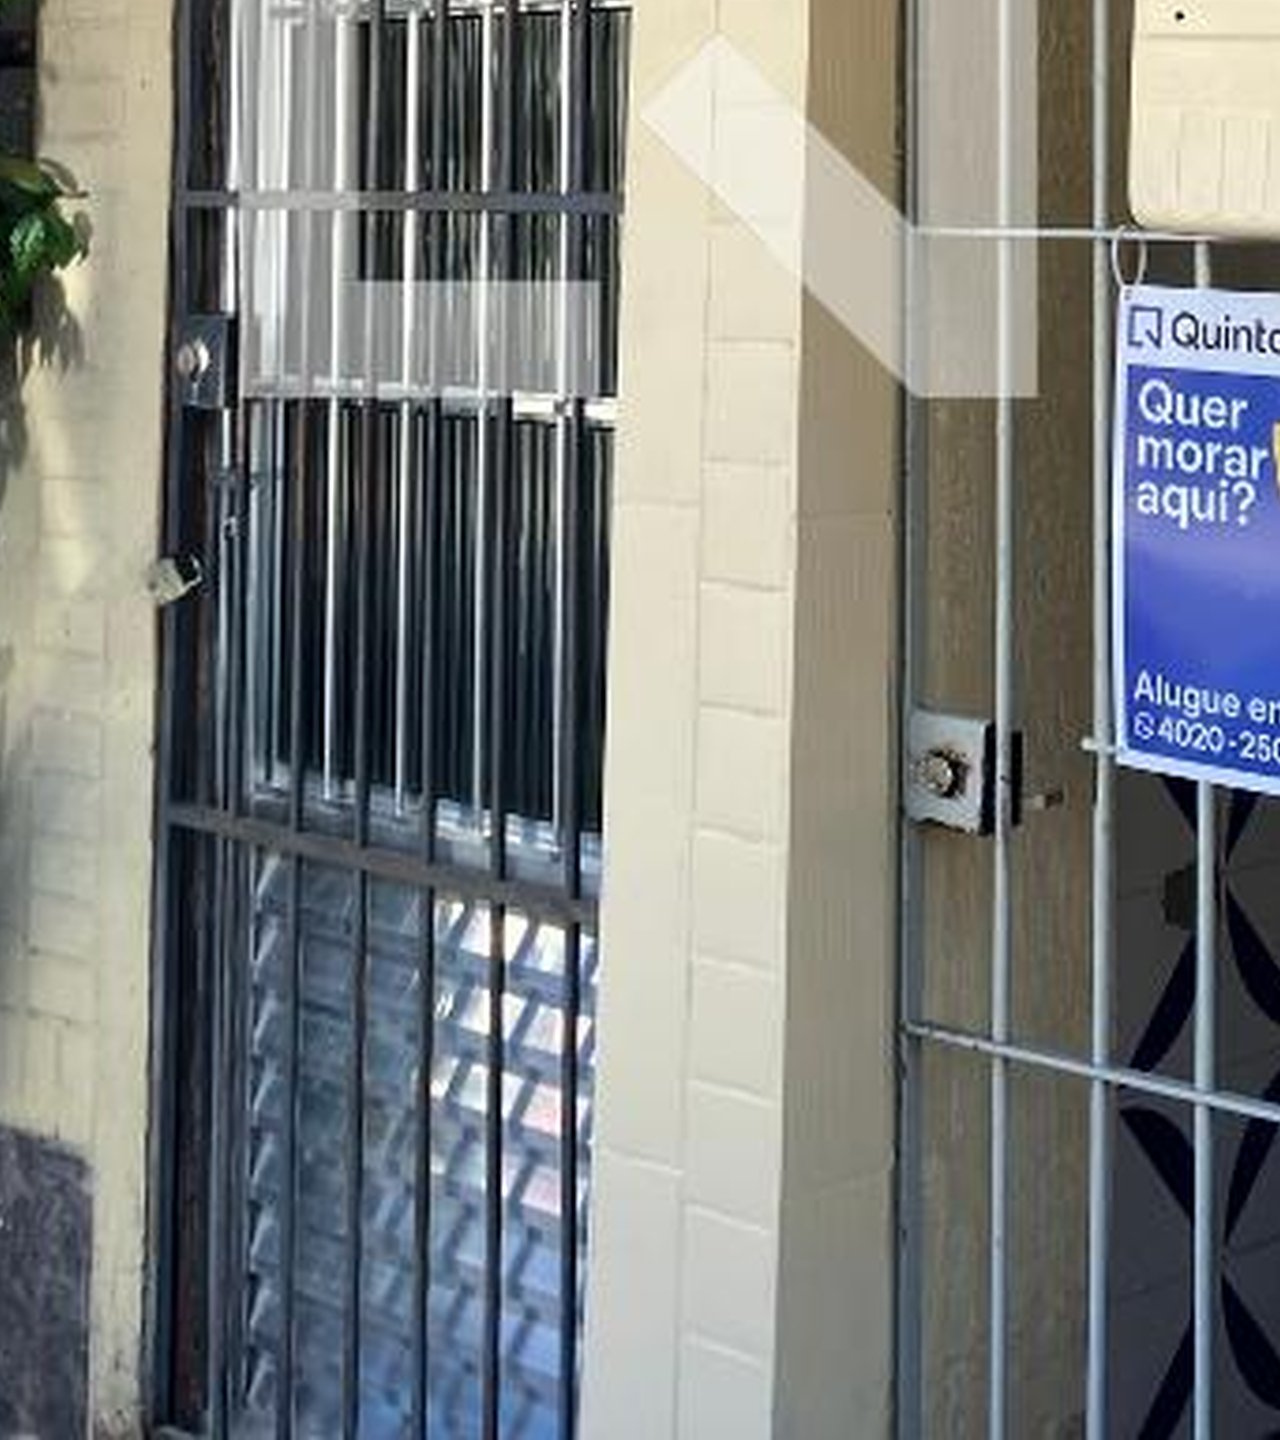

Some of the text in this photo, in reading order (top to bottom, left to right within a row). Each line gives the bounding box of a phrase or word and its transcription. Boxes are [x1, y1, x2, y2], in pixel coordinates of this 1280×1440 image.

[1138, 379, 1248, 429] Quer
[1137, 436, 1271, 481] morar
[1136, 480, 1257, 530] aqui?
[1134, 670, 1241, 718] Alugue
